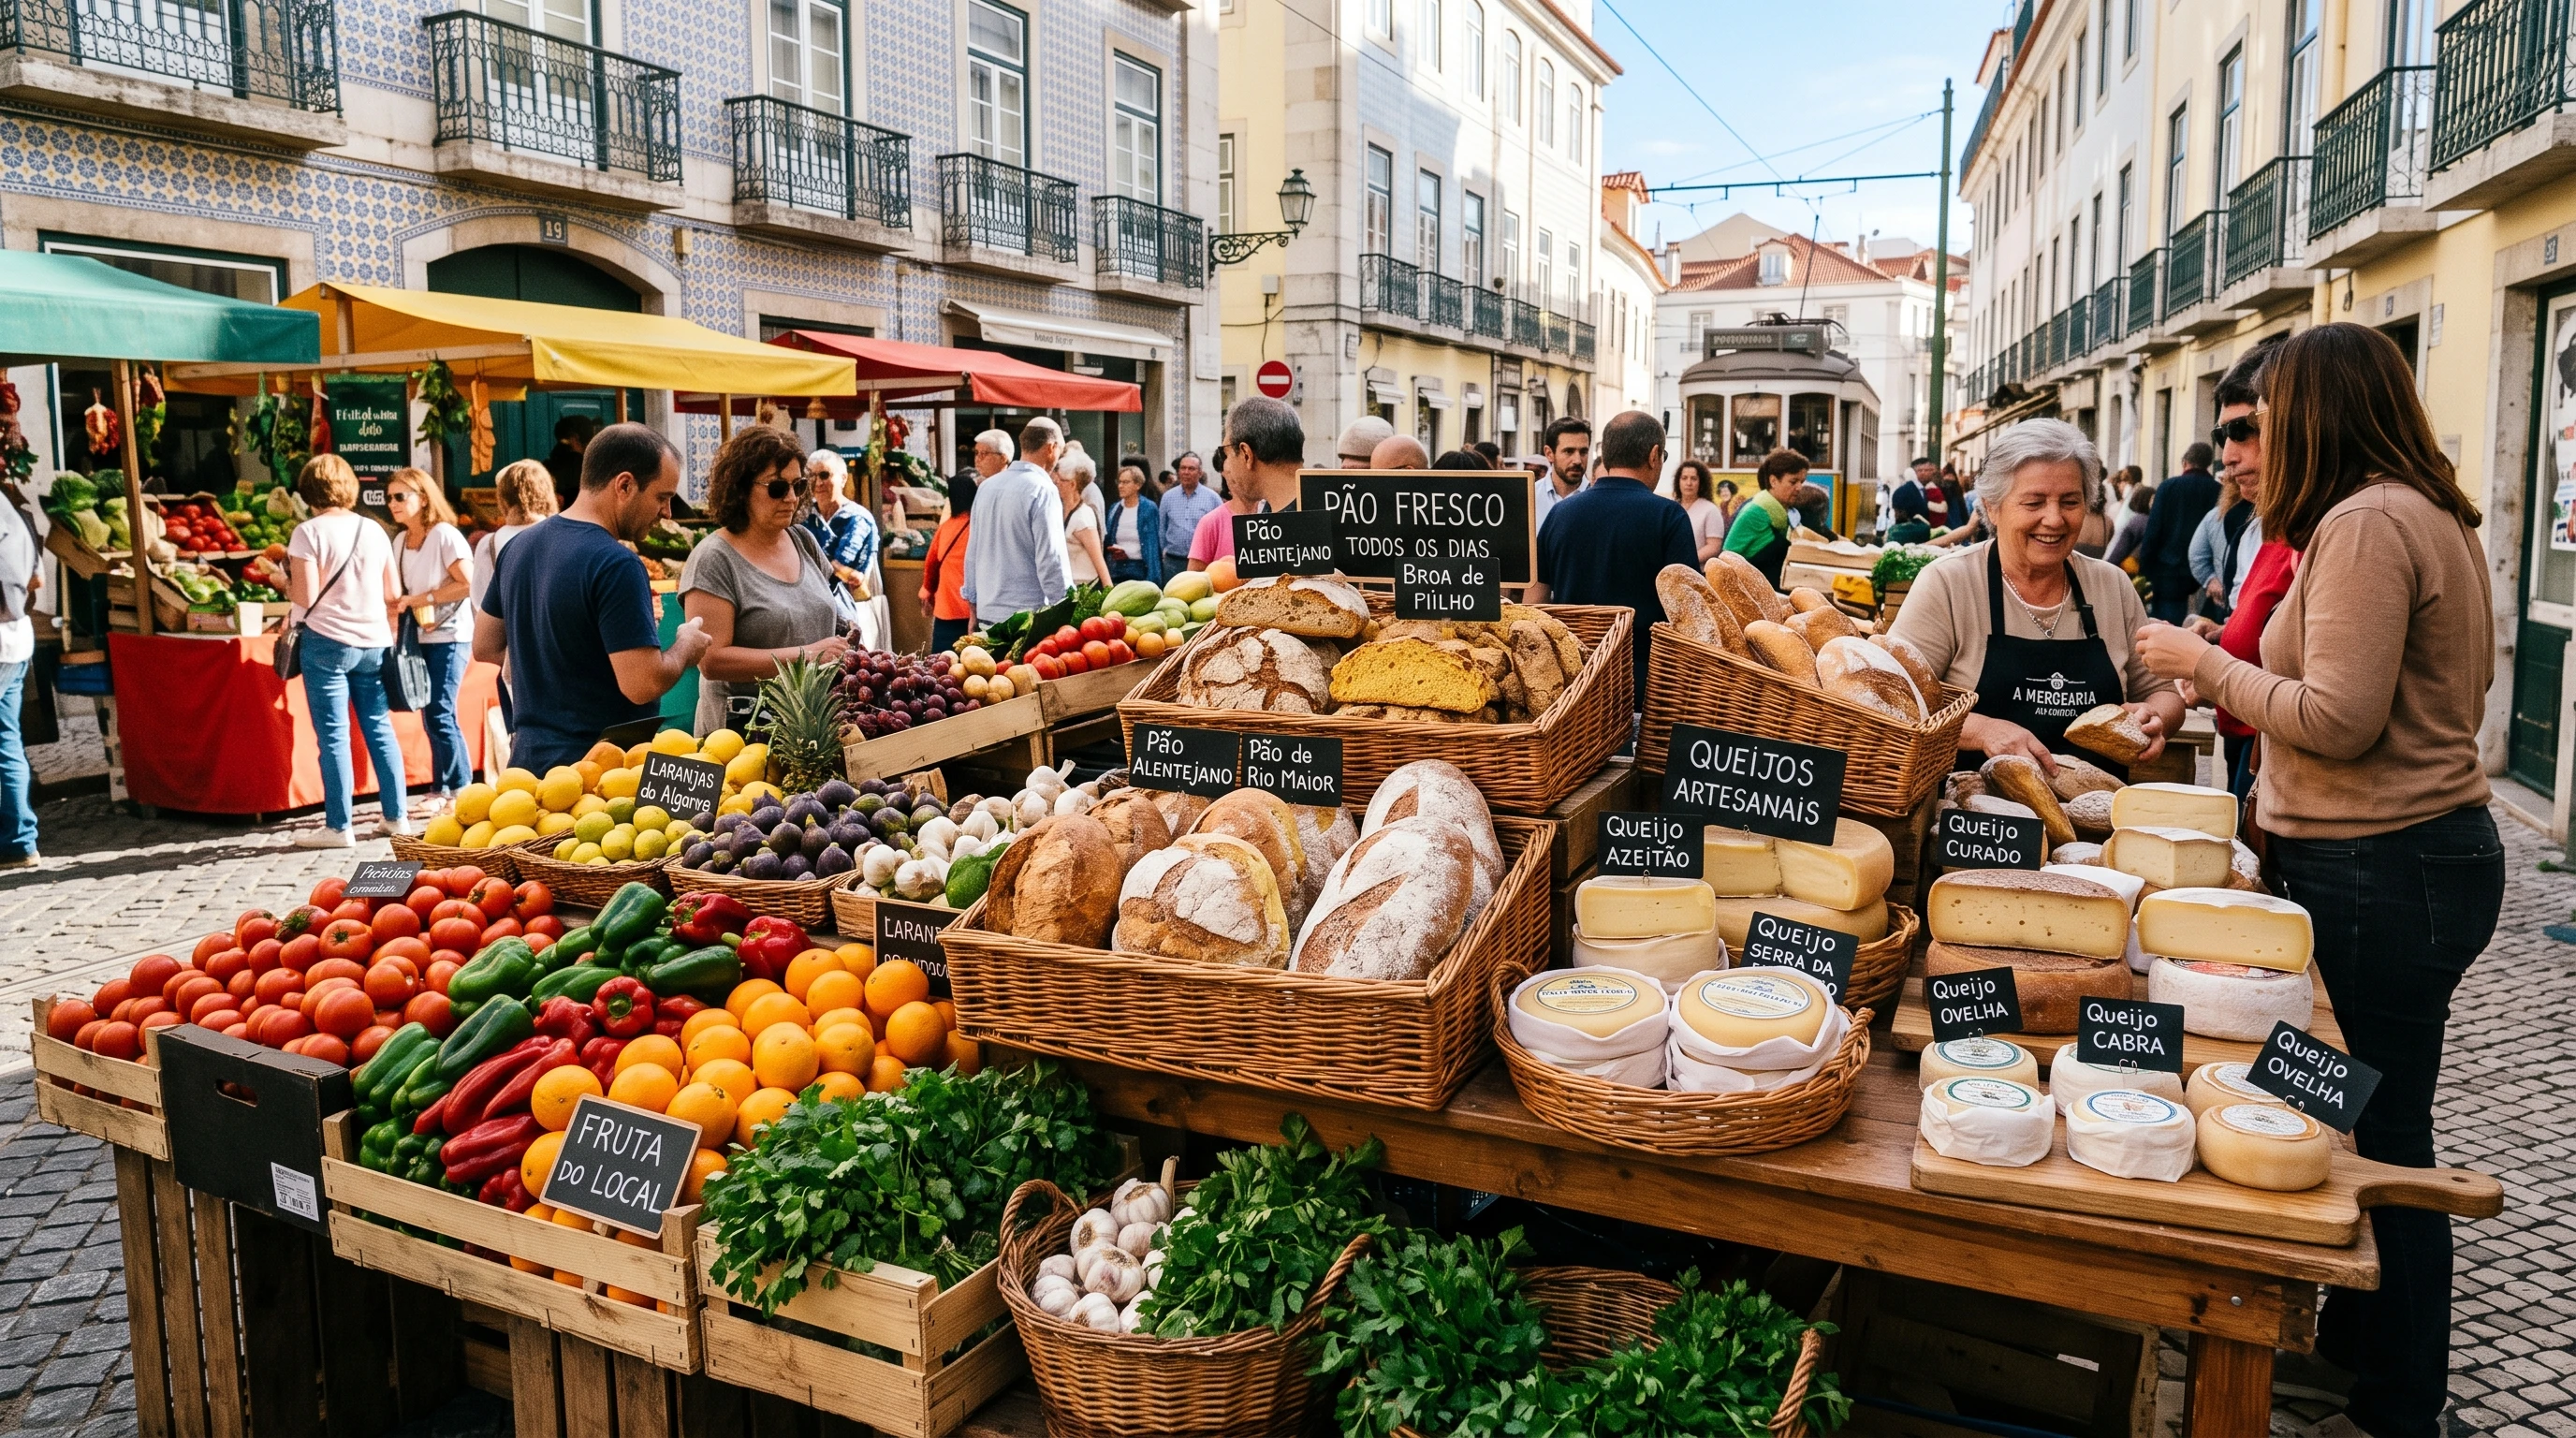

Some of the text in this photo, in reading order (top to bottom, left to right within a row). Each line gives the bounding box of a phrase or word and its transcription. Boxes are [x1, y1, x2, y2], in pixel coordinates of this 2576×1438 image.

[546, 220, 563, 239] 19
[1325, 482, 1504, 527] PÃO FRESCO
[1246, 518, 1282, 541] Pão
[1345, 536, 1490, 559] TODOS OS DIAS
[1461, 564, 1485, 586] de
[2012, 686, 2022, 701] A
[1147, 729, 1184, 756] Pão
[1249, 738, 1312, 764] Pão de
[1247, 765, 1275, 787] Rio
[640, 781, 656, 800] do
[1749, 943, 1835, 977] SERRA DA
[1932, 976, 1996, 1001] Queijo
[1940, 1001, 2009, 1025] OVELHA
[2086, 1003, 2158, 1031] Queijo
[2092, 1031, 2165, 1056] CABRA
[2276, 1030, 2349, 1078] Queijo
[2267, 1056, 2344, 1109] OVELHA
[577, 1112, 662, 1167] FRUTA
[558, 1160, 662, 1214] DO LOCAL
